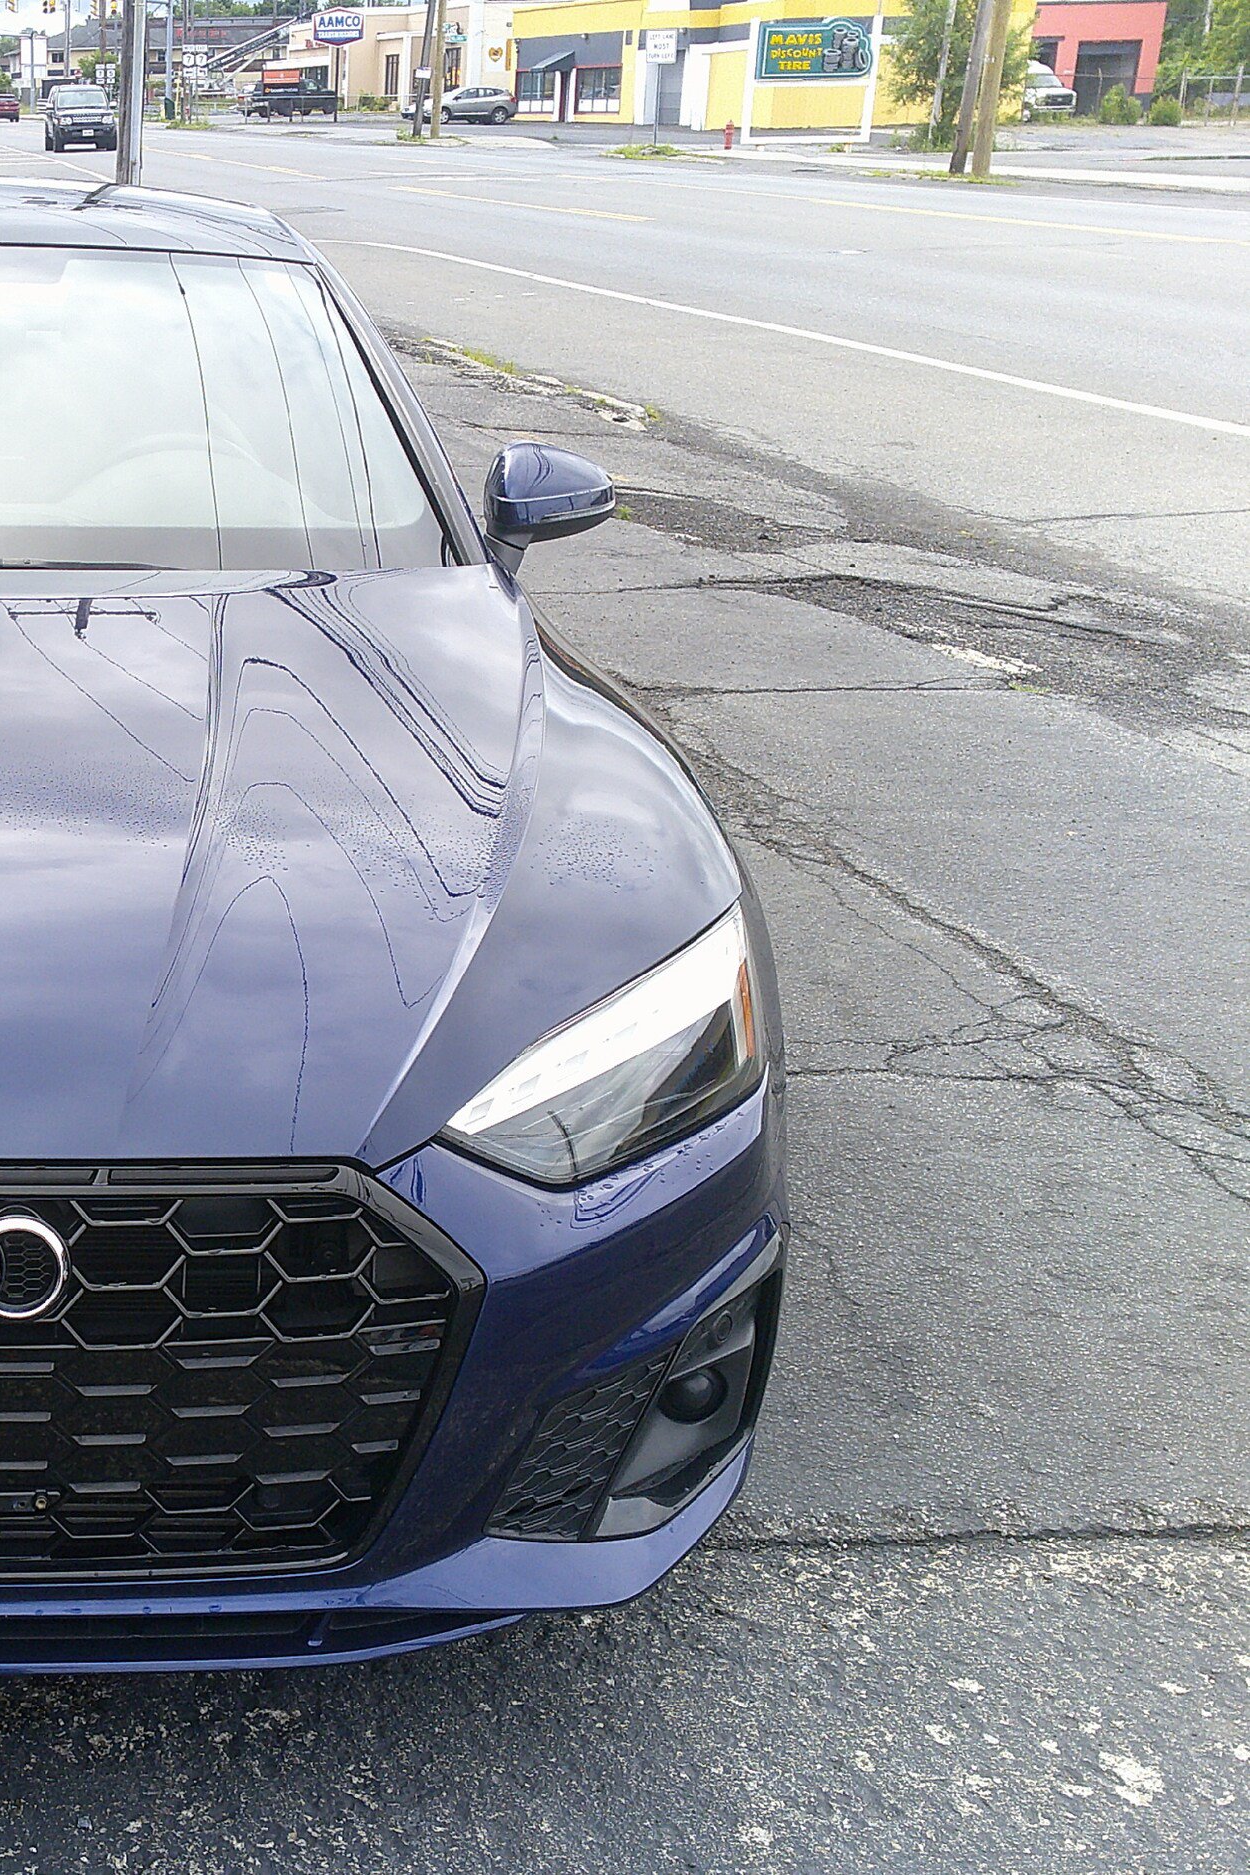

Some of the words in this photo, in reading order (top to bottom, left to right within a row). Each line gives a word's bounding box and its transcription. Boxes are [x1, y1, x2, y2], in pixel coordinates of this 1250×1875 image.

[318, 15, 361, 28] AAMCO
[770, 33, 823, 45] MAVIS
[770, 47, 823, 59] DISCOUNT
[778, 60, 811, 70] TIRE
